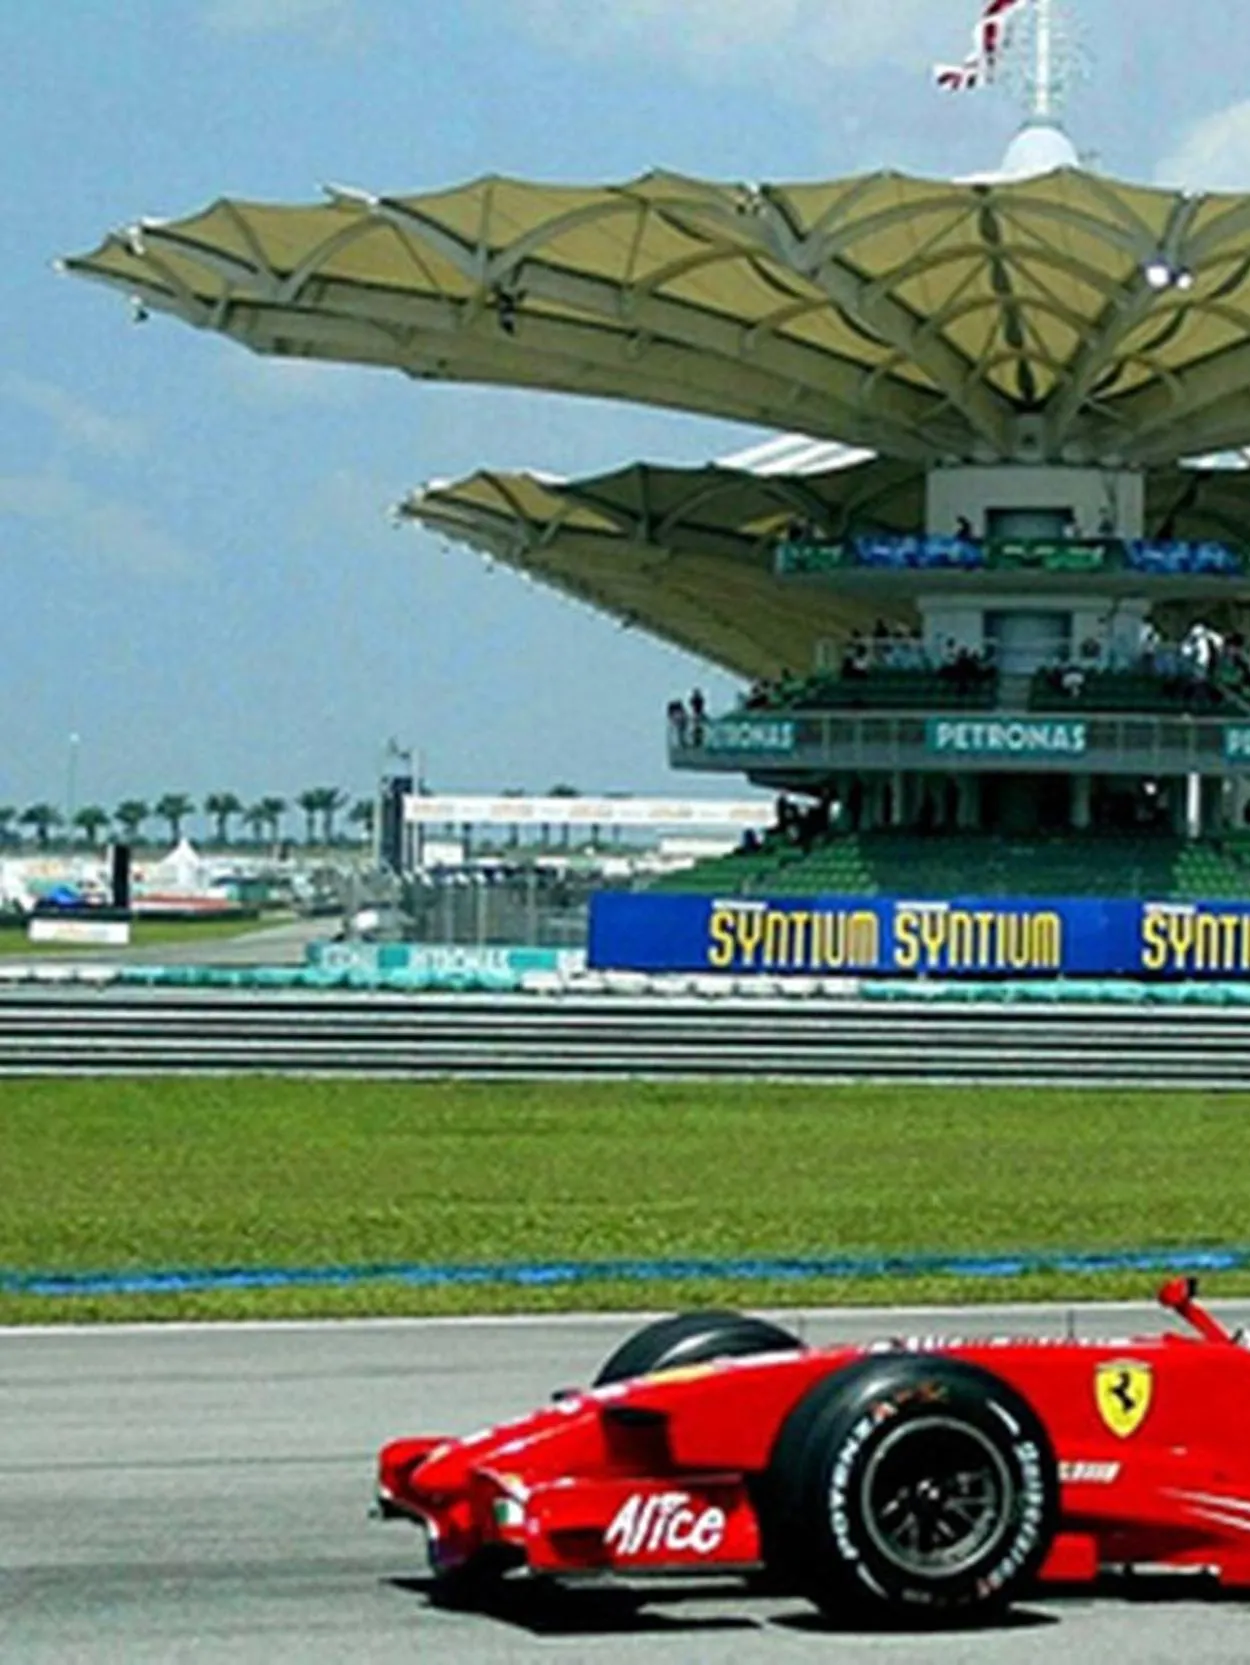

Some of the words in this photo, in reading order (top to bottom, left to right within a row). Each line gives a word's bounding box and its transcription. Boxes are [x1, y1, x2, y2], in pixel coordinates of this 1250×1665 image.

[935, 721, 1087, 751] PETRONAS
[708, 910, 879, 968] SYNTIUM
[893, 911, 1062, 968] SYNTIUM
[602, 1490, 726, 1557] Alice
